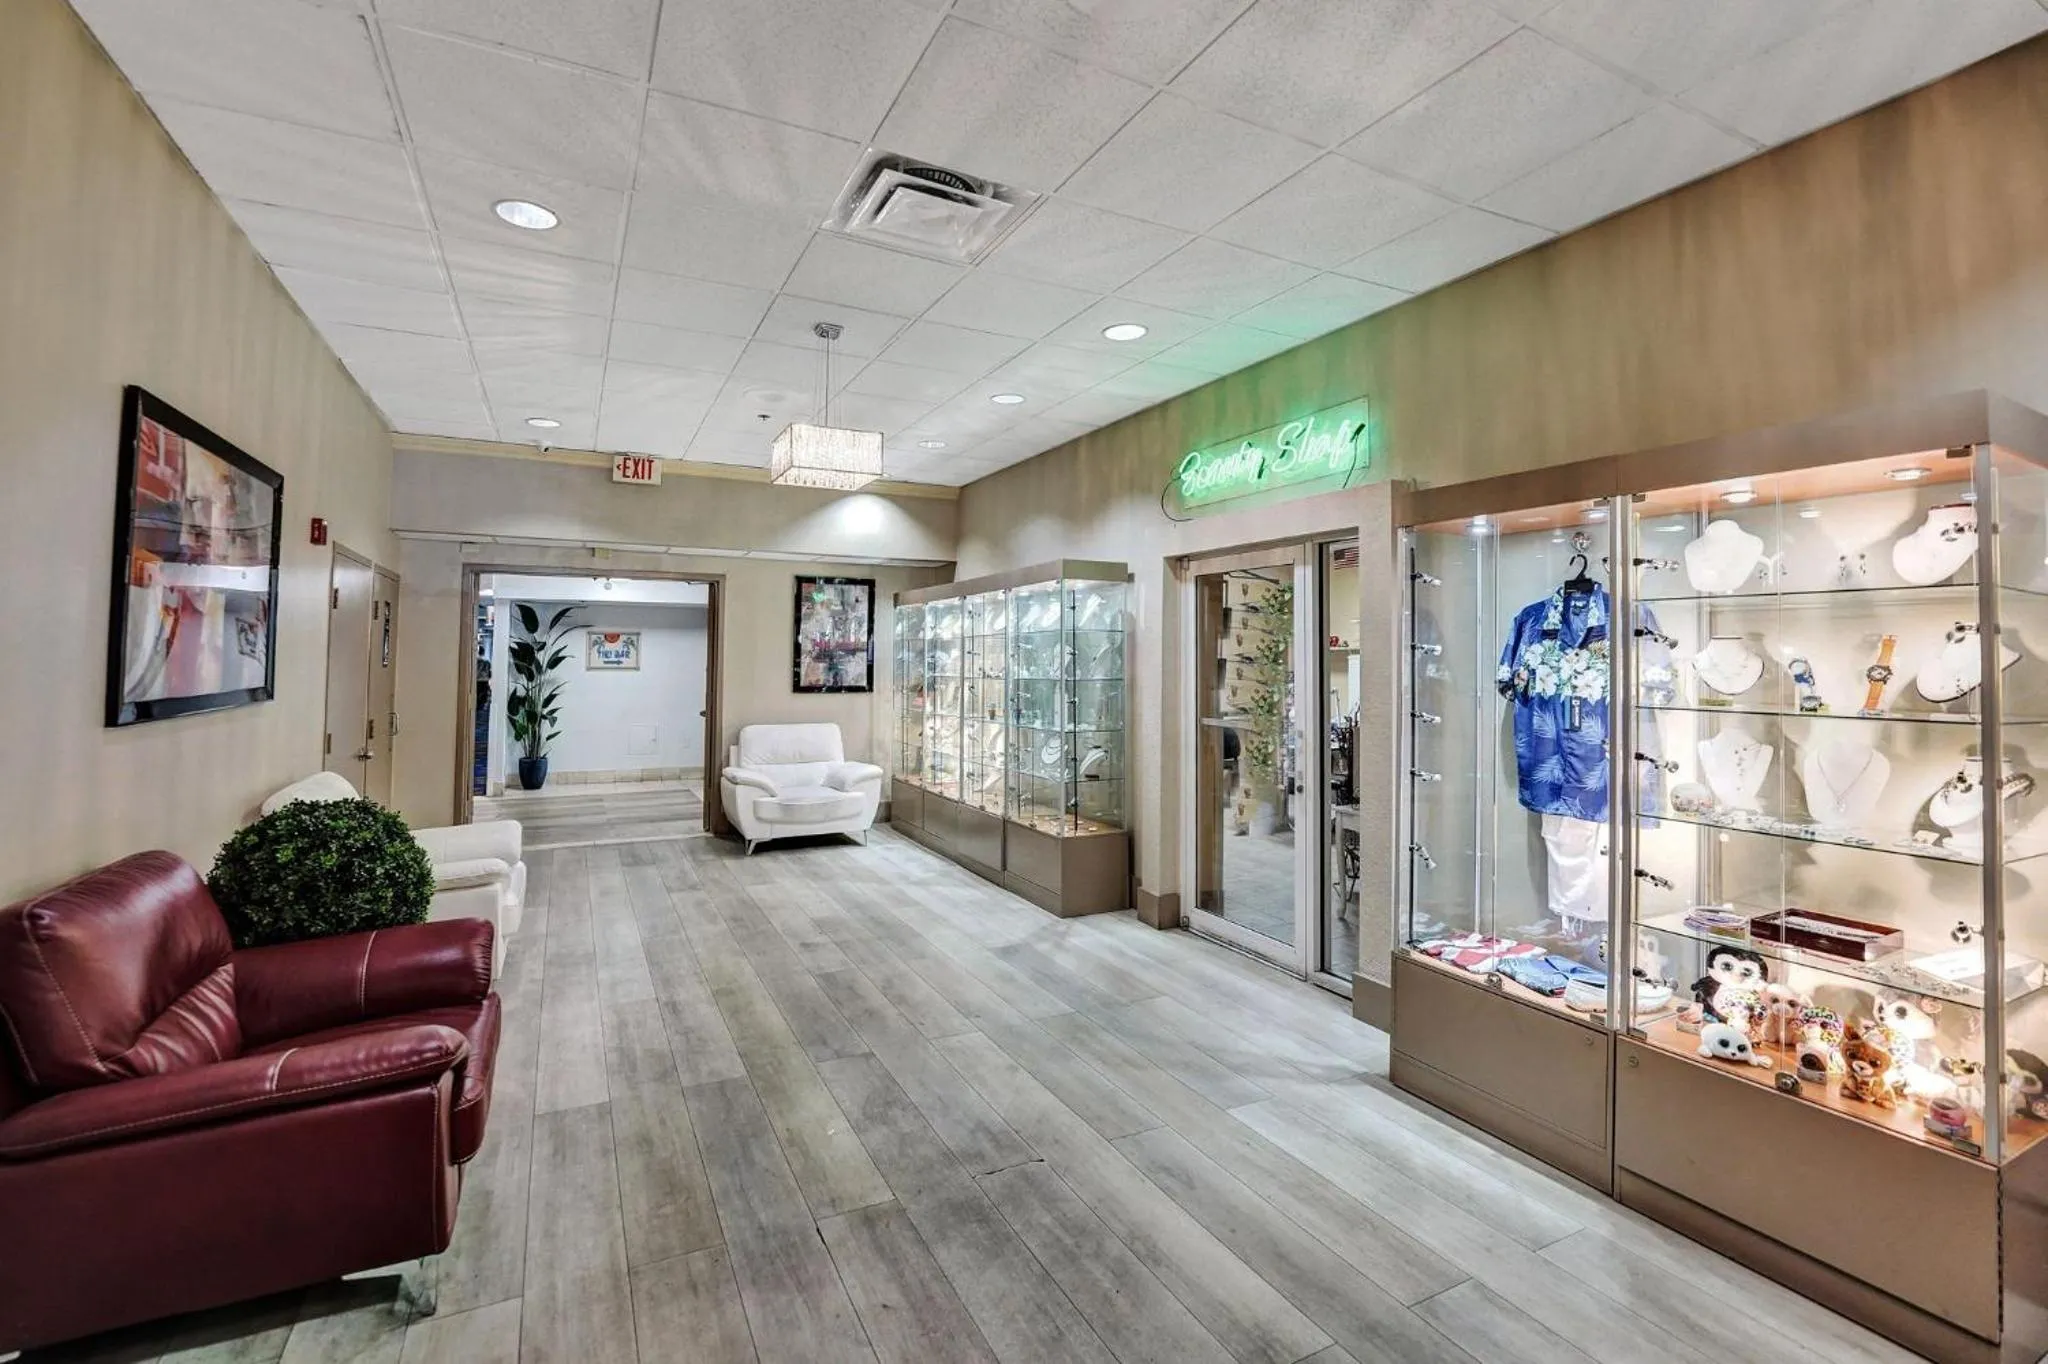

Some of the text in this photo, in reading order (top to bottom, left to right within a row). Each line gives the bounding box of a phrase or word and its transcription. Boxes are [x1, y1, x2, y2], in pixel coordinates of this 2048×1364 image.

[1271, 416, 1355, 472] Shop
[622, 457, 654, 480] EXIT
[614, 649, 631, 659] BAR
